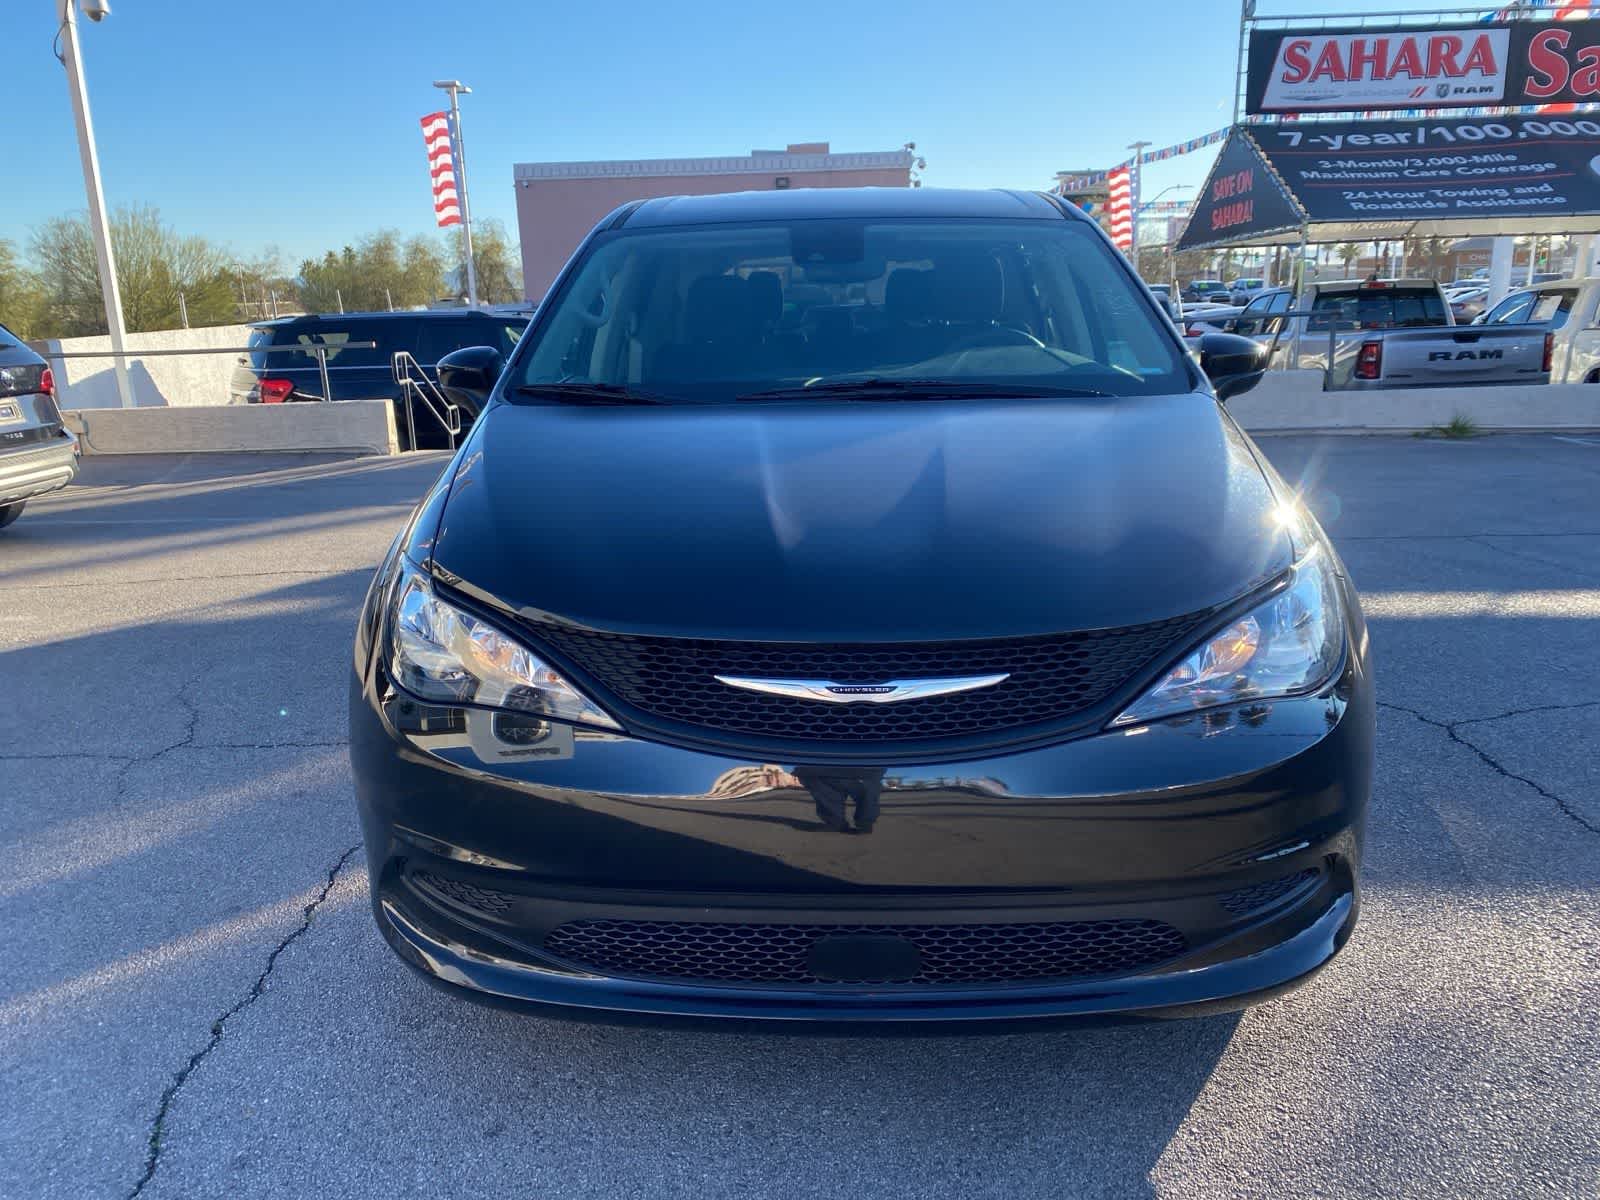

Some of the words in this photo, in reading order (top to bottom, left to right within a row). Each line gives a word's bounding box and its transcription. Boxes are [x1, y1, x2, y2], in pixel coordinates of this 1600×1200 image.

[1282, 34, 1498, 83] SAHARA
[1453, 85, 1494, 95] RAM
[1318, 153, 1518, 168] 3-Month/3,000-Mile
[1300, 170, 1399, 179] Maximum
[1403, 168, 1450, 177] Care
[1456, 162, 1557, 175] Coverage
[1342, 190, 1426, 200] 24-Hour
[1429, 187, 1510, 198] Towing
[1513, 183, 1554, 194] and
[1350, 200, 1449, 210] Roadside
[1456, 196, 1567, 207] Assistance
[1212, 200, 1253, 230] SAHARA!
[1428, 350, 1503, 361] RAM
